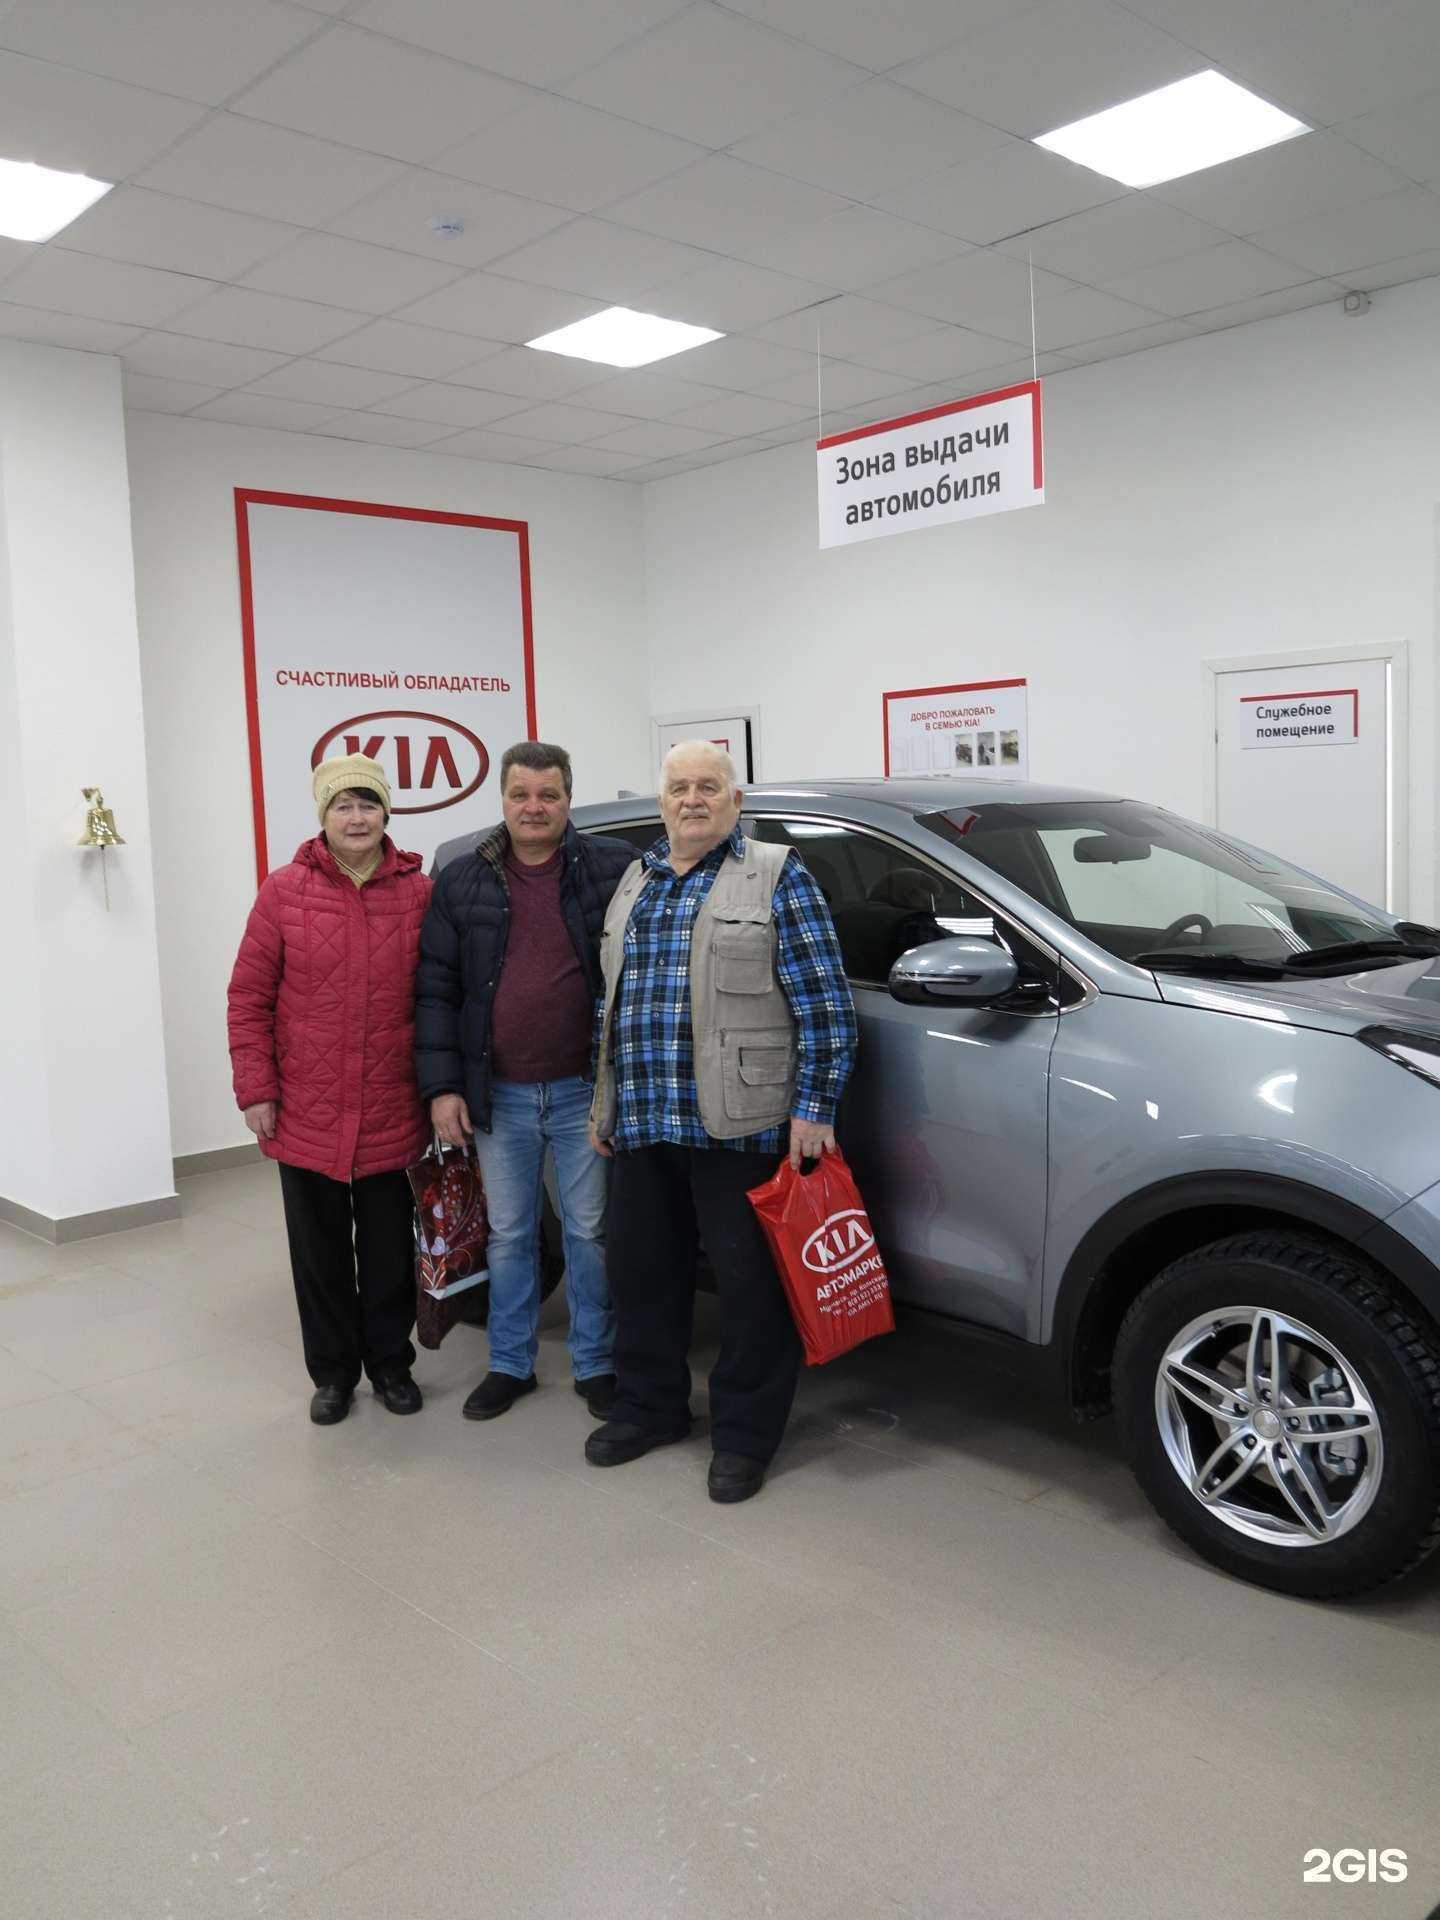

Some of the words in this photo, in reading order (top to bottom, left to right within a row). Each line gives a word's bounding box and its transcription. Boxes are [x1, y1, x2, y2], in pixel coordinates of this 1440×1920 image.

[835, 450, 896, 485] Зона
[905, 421, 1009, 466] выдачи
[845, 470, 1001, 525] автомобиля
[275, 669, 400, 690] СЧАСТЛИВЫЙ
[404, 674, 512, 694] ОБЛАДАТЕЛЬ
[910, 710, 938, 723] ДОБРО
[939, 705, 996, 719] ПОЖАЛОВАТЬ
[1256, 703, 1332, 722] Служебное
[925, 721, 931, 731] В
[932, 719, 963, 730] СЕМЬЮ
[964, 718, 981, 727] KIA!
[1256, 723, 1335, 738] помещение
[813, 1218, 872, 1267] KIA
